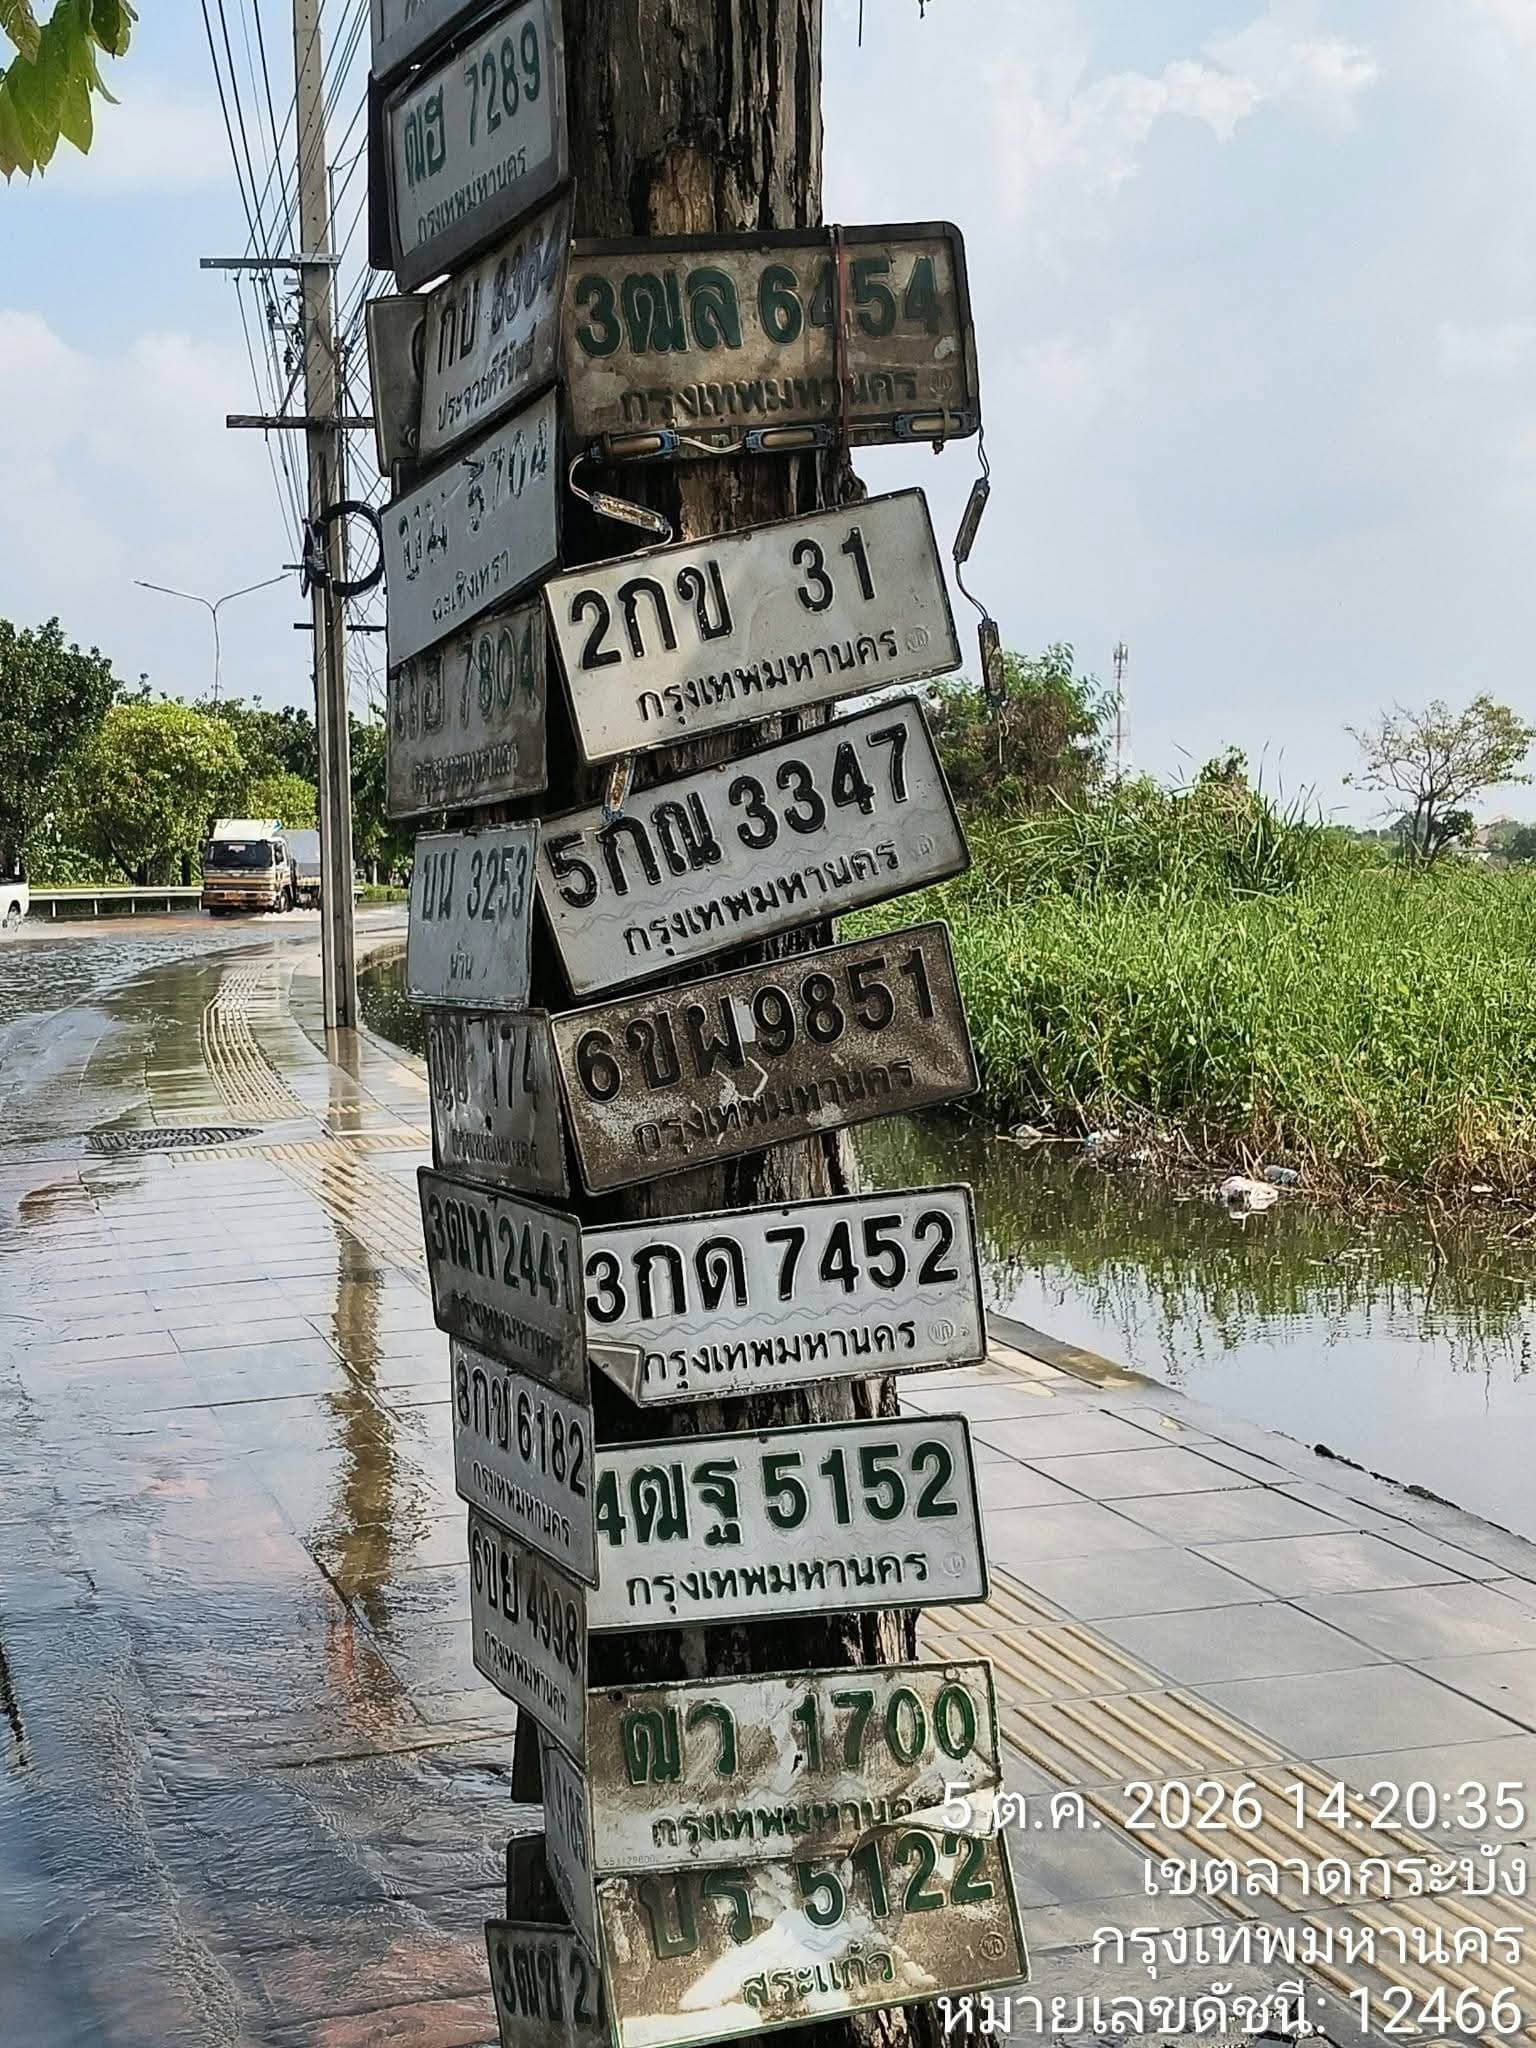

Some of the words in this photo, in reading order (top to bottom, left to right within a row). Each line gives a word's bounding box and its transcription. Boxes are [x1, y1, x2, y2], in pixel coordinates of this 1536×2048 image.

[464, 20, 541, 146] 7289
[418, 148, 528, 243] กรงเทพมหานคร
[576, 265, 742, 358] 3ฒล
[757, 255, 943, 346] 6454
[570, 560, 734, 671] 2กข
[791, 527, 876, 613] 31
[637, 629, 899, 724] กรุงเทพมหานคร
[728, 723, 911, 850] 3347
[467, 843, 528, 922] 3253
[623, 841, 899, 956] กรุงเทพมหานคร
[751, 947, 937, 1057] 9851
[498, 1214, 577, 1316] 2441
[585, 1235, 748, 1324] 3กด
[765, 1209, 959, 1301] 7452
[643, 1321, 916, 1389] กรุงเทพมหานคร
[517, 1389, 587, 1497] 6182
[597, 1459, 743, 1546] 4ฒฐ
[761, 1441, 958, 1530] 5152
[472, 1459, 572, 1550] กรุงเทพมหานคร
[526, 1568, 580, 1677] 4998
[626, 1553, 929, 1614] กรุงเทพมหานคร
[484, 1627, 568, 1725] กรุงเทพมหานคร
[793, 1684, 978, 1773] 1700
[652, 1798, 914, 1857] กรุงเทพมหานค
[799, 1830, 995, 1930] 5122
[742, 1943, 897, 2009] สระแก้ว
